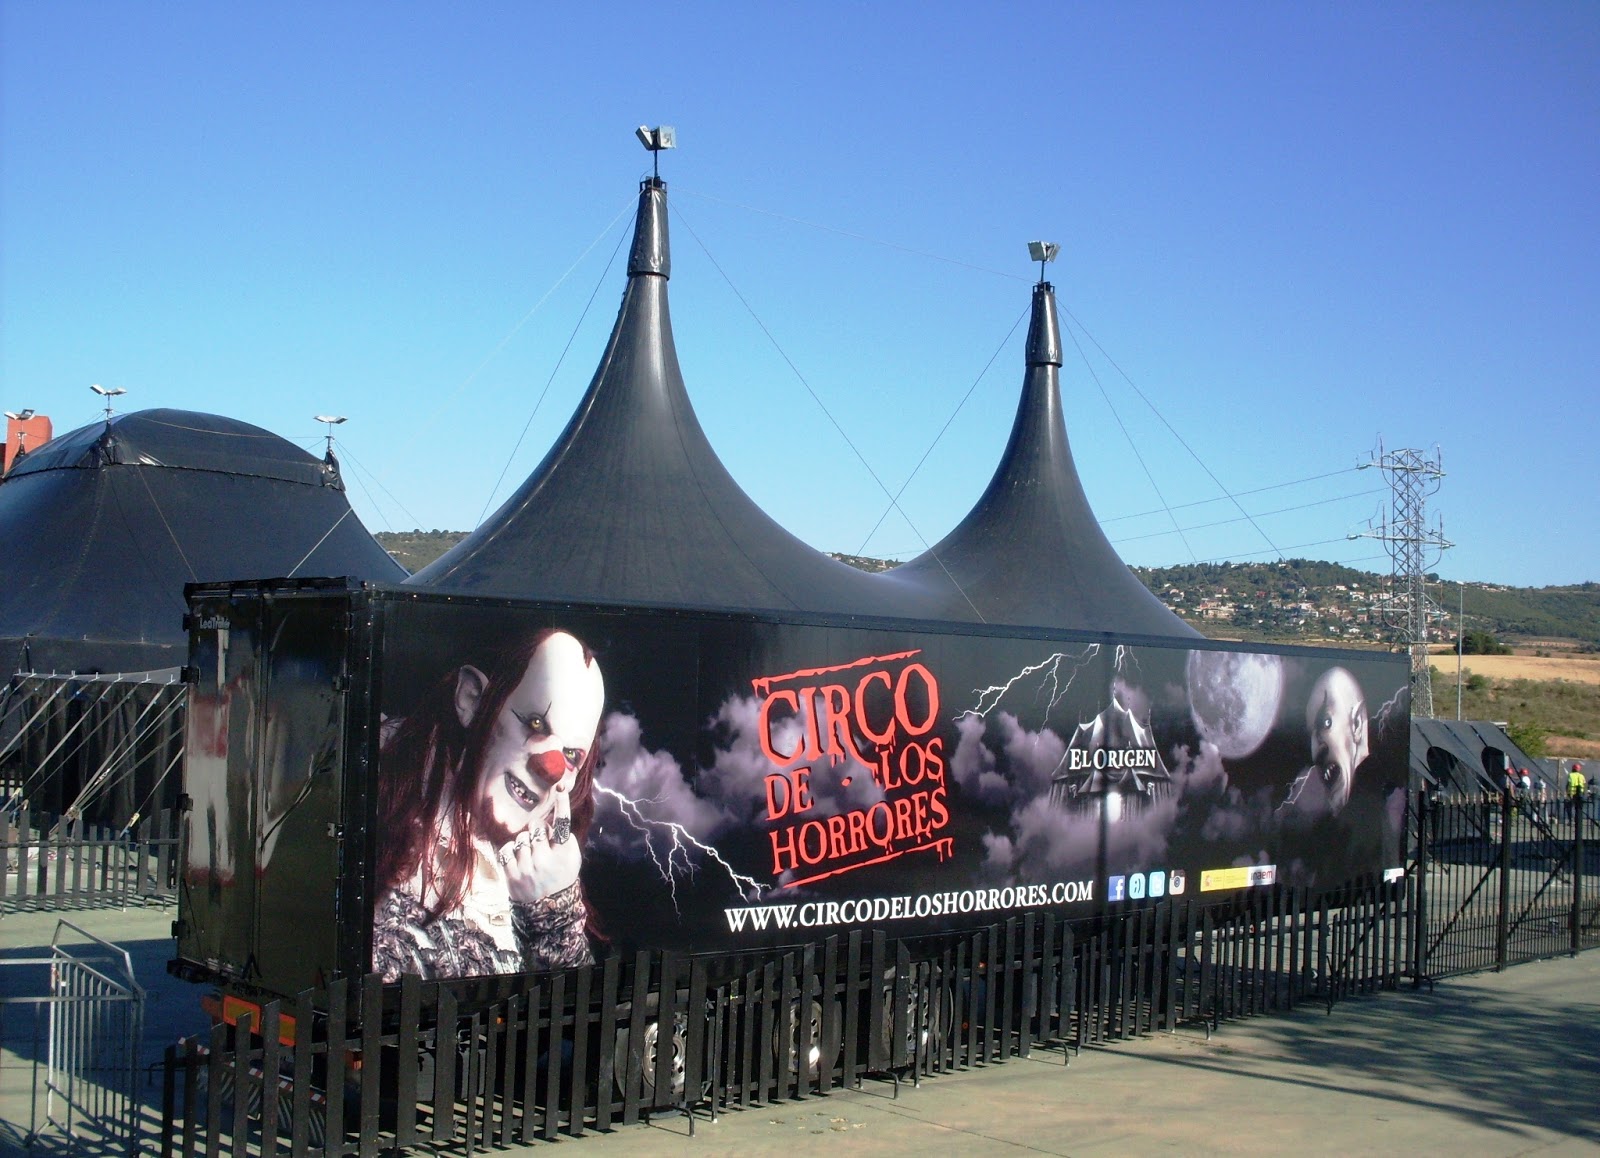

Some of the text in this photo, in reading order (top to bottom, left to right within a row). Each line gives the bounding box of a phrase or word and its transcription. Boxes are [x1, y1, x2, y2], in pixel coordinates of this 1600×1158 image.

[758, 663, 939, 767] CIRCO
[764, 737, 945, 821] DE LOS
[769, 787, 949, 874] HORRORES
[724, 880, 1094, 932] WWW.CIRCODELOSHORRORES.COM
